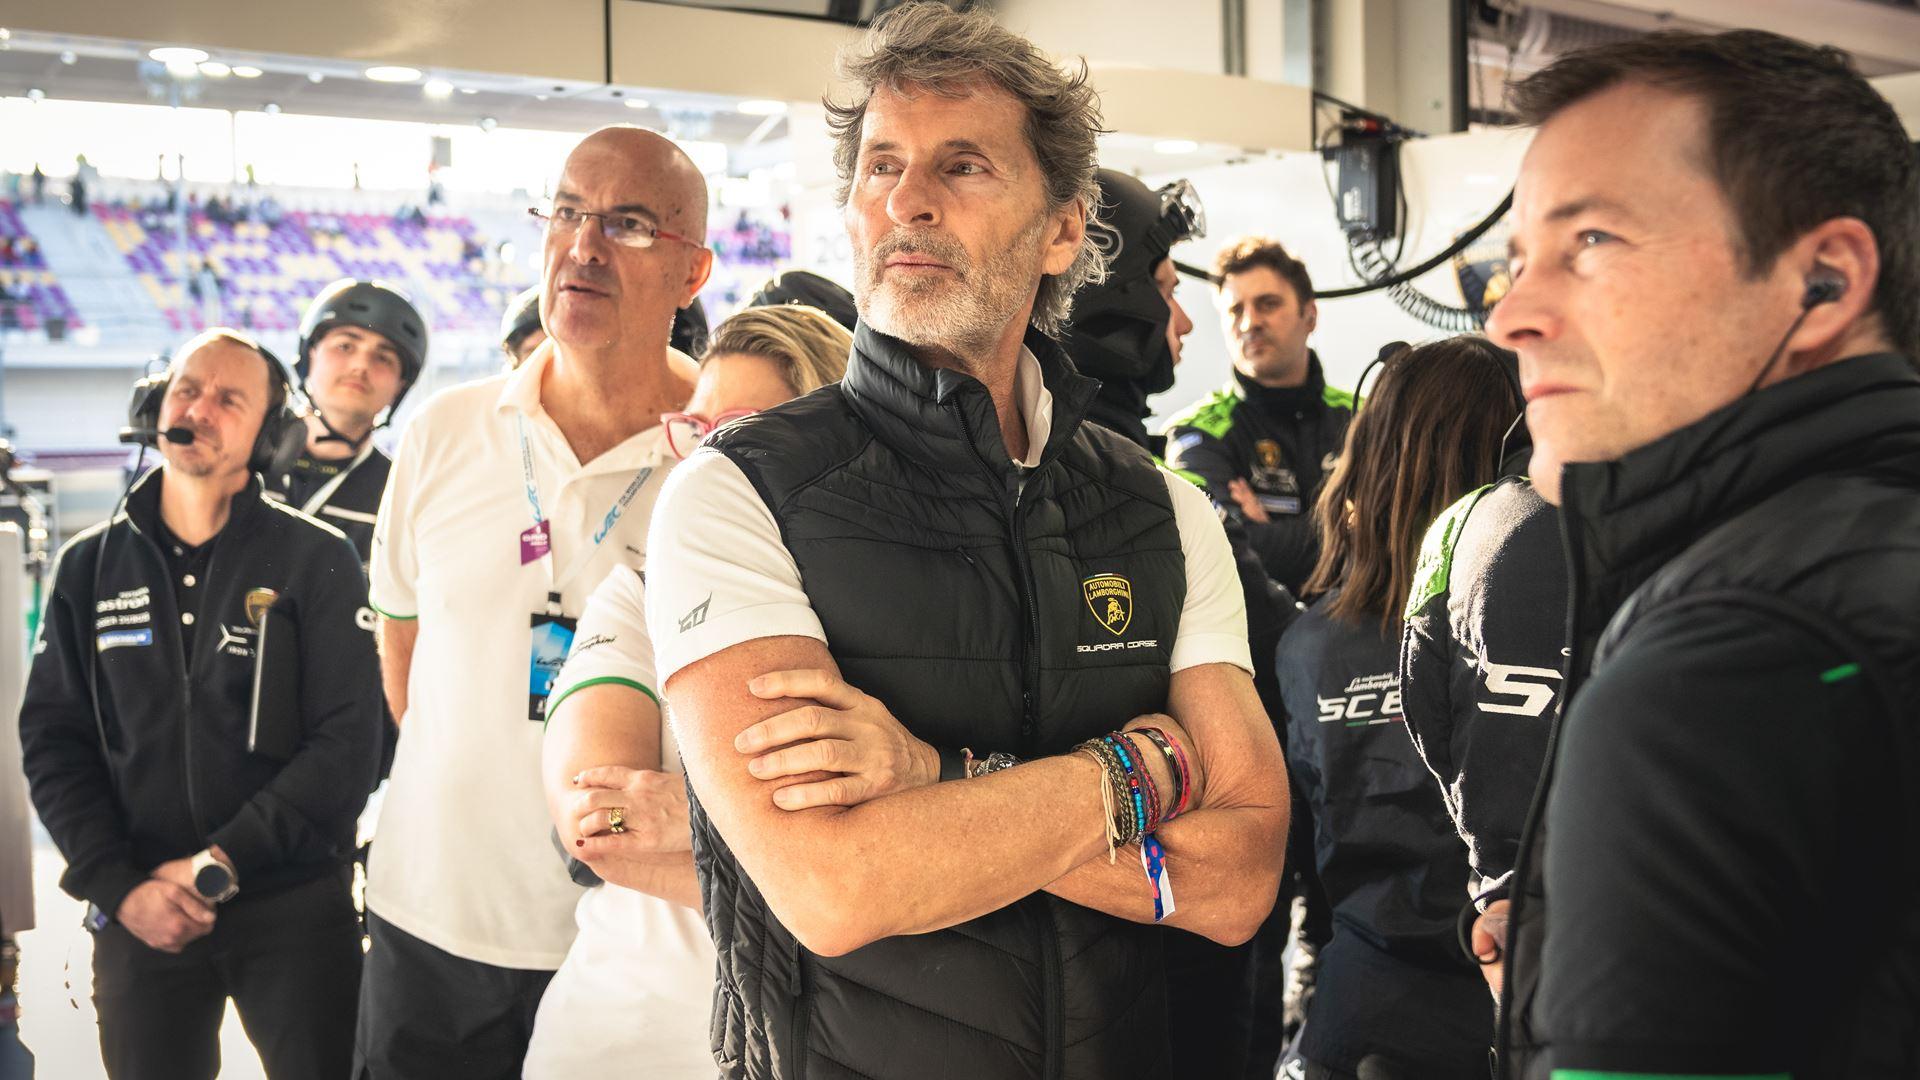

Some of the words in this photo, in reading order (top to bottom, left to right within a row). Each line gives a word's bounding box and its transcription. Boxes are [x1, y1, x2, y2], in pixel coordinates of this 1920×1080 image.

[1089, 580, 1126, 590] AUTOMOBILI
[1088, 588, 1130, 601] LAMBORGHINI
[1077, 642, 1125, 653] SQUADRA
[1126, 640, 1157, 649] CORSE
[1477, 644, 1564, 717] S
